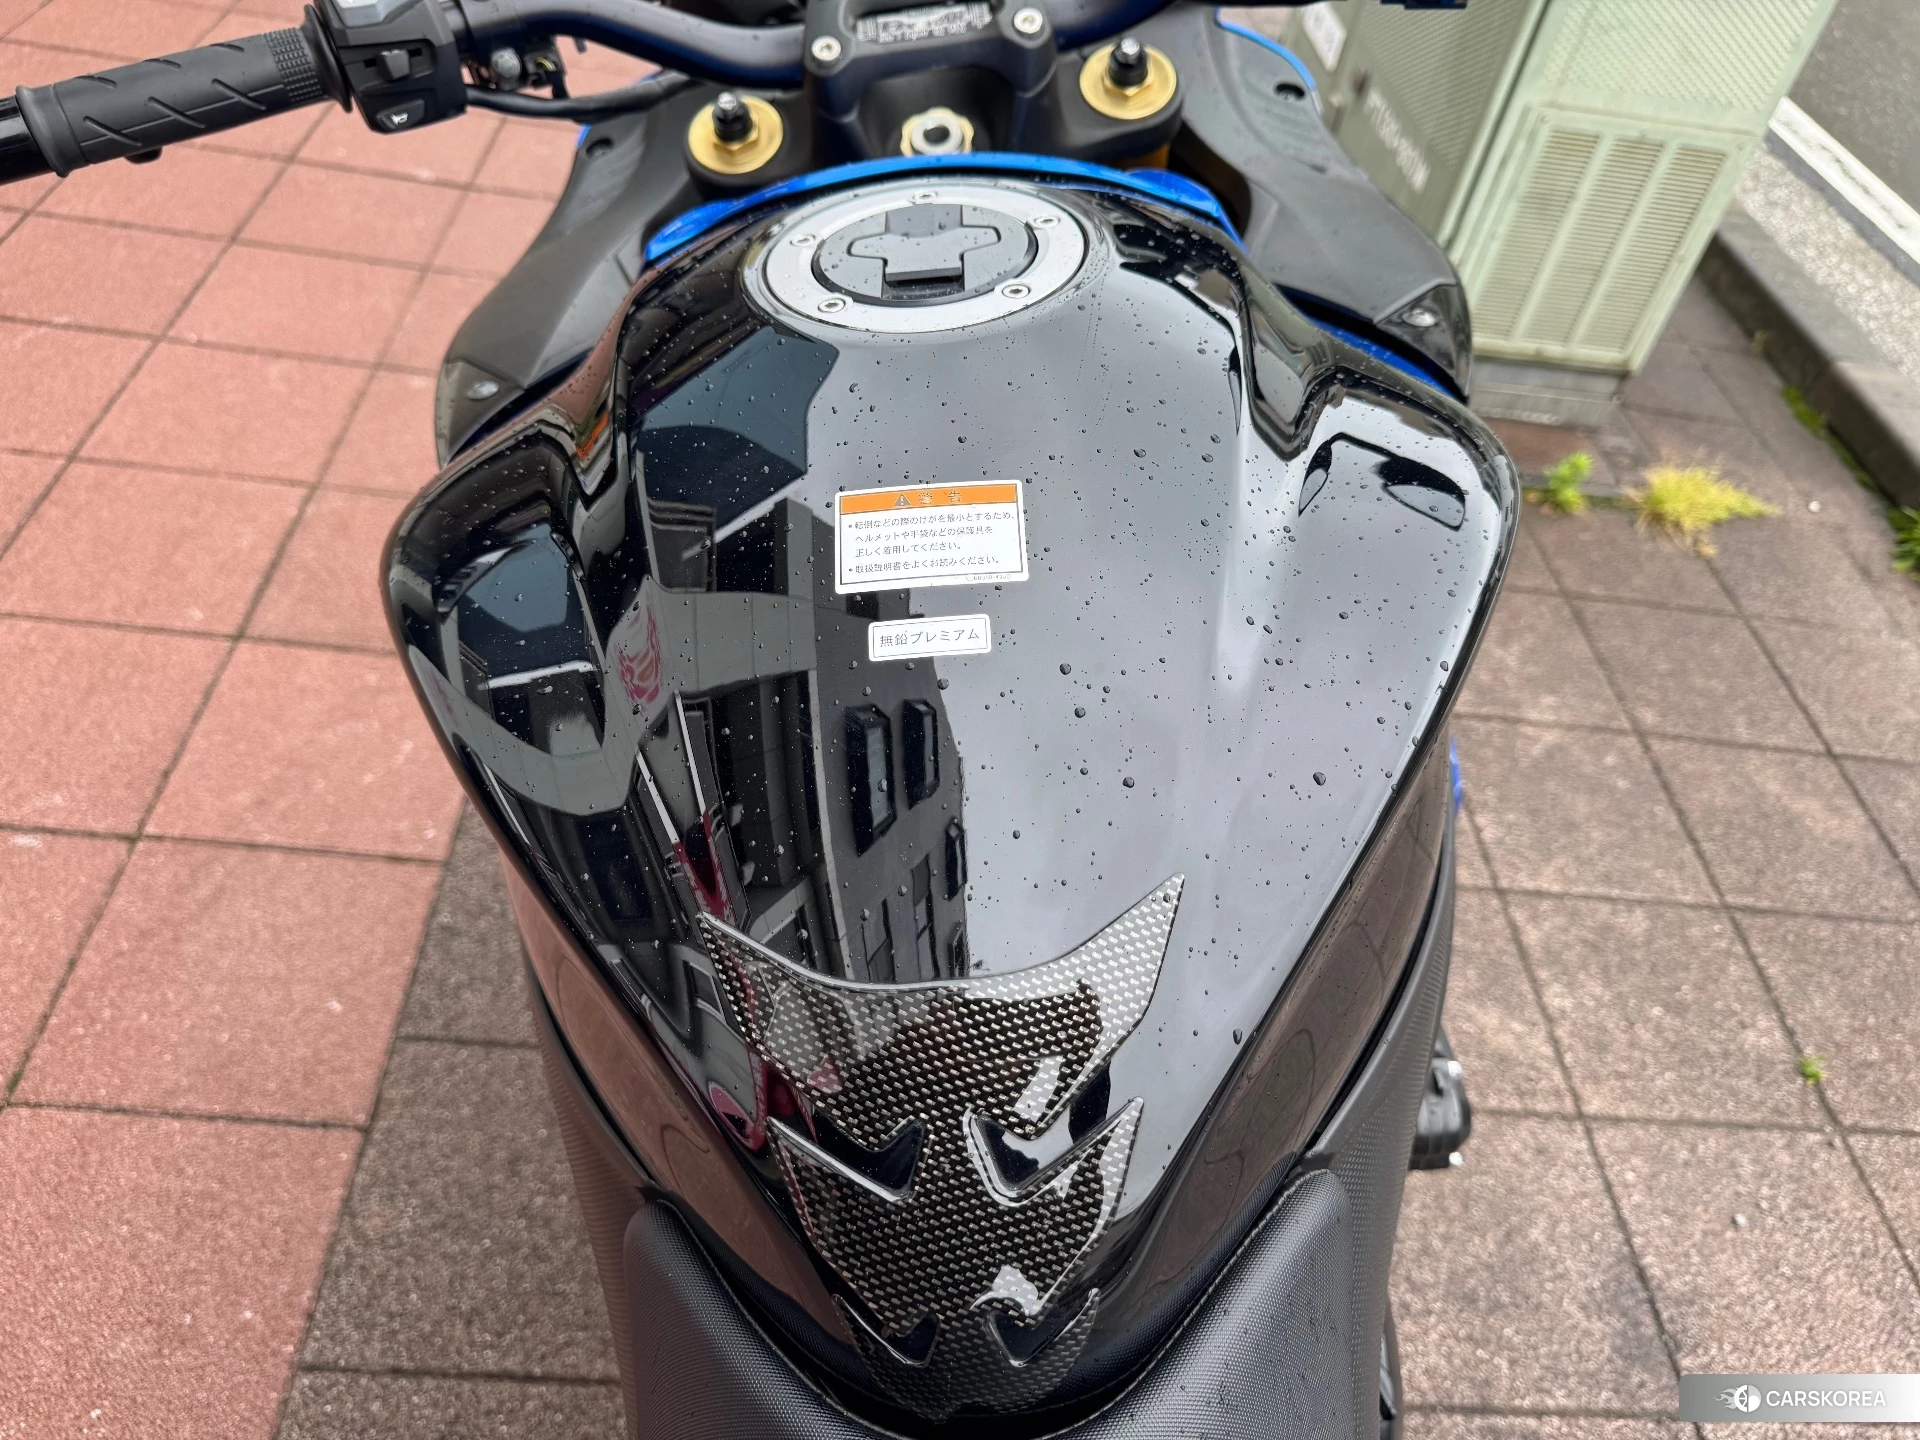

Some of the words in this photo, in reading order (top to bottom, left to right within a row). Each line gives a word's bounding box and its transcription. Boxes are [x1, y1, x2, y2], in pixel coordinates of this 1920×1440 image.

[879, 628, 980, 648] 無鉛プレミアム
